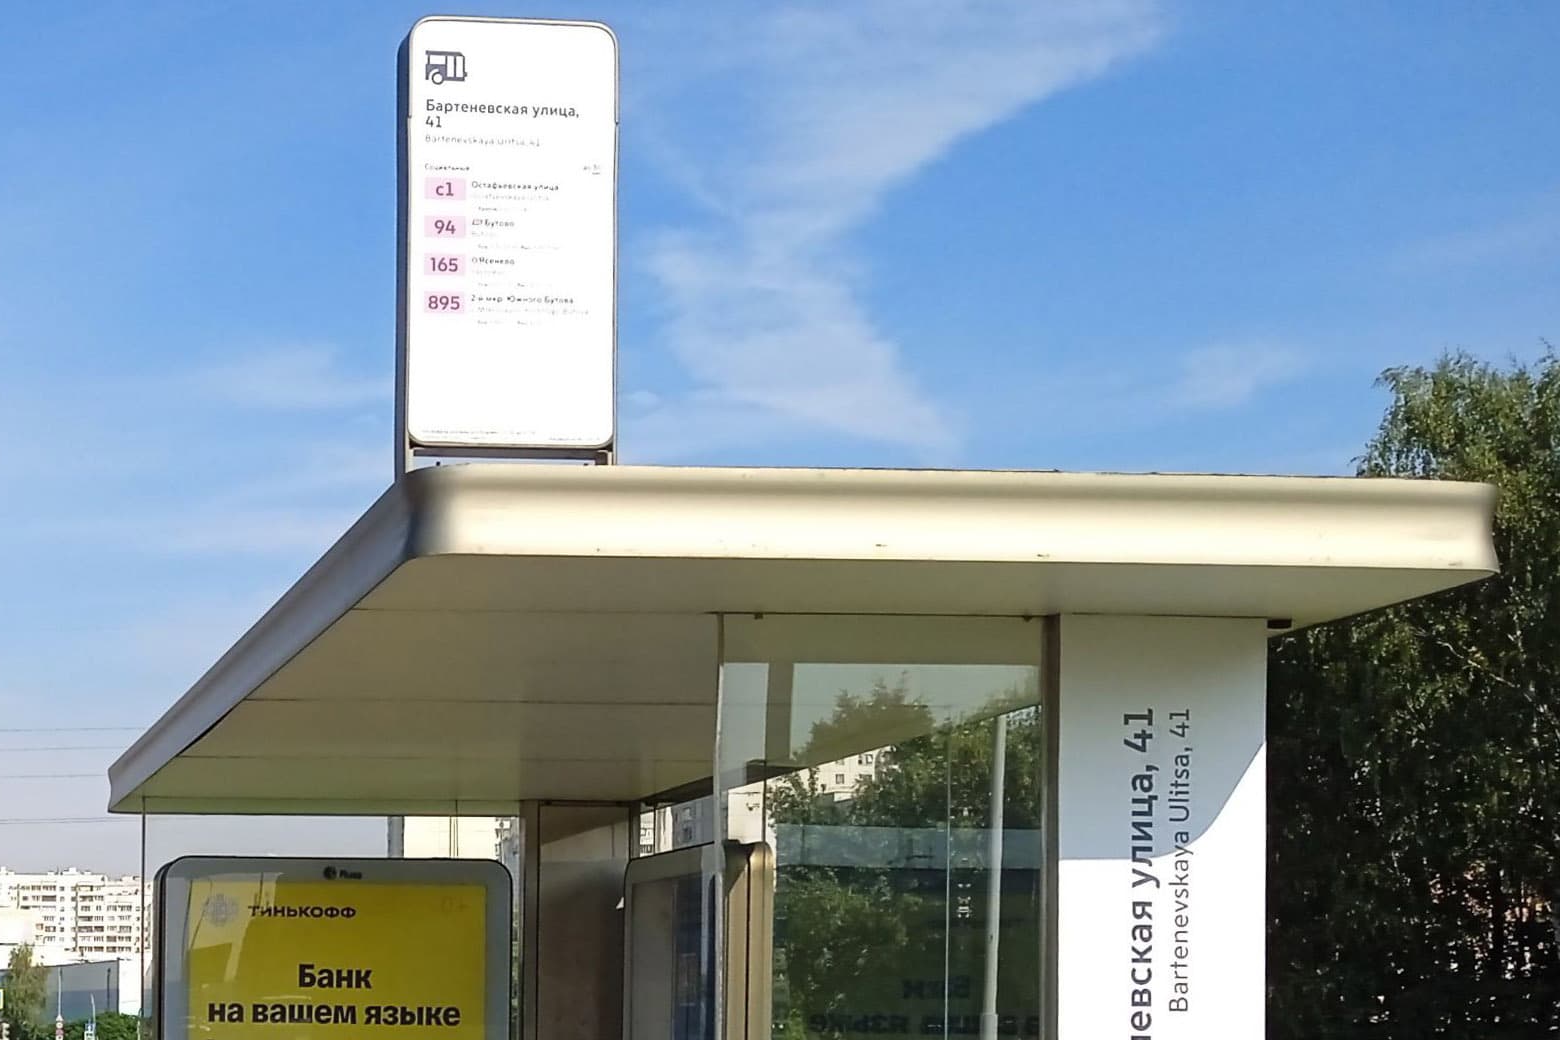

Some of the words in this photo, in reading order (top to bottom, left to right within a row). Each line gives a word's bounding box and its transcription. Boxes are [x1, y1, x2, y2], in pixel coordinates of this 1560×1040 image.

[426, 99, 528, 115] Бартеневская
[532, 106, 580, 119] улица,
[425, 116, 442, 128] 41
[434, 219, 456, 235] 94
[430, 257, 458, 273] 165
[428, 295, 460, 310] 895
[1123, 707, 1153, 755] 41
[1169, 707, 1191, 739] 41
[1168, 746, 1194, 822] Ulitsa,
[1130, 763, 1161, 888] улица,
[248, 904, 356, 919] ТИНЬКОФФ
[1168, 830, 1193, 1013] Bartenevskaya
[298, 963, 372, 989] Банк
[208, 1003, 244, 1024] на
[252, 1003, 357, 1025] вашем
[364, 1005, 461, 1026] языке
